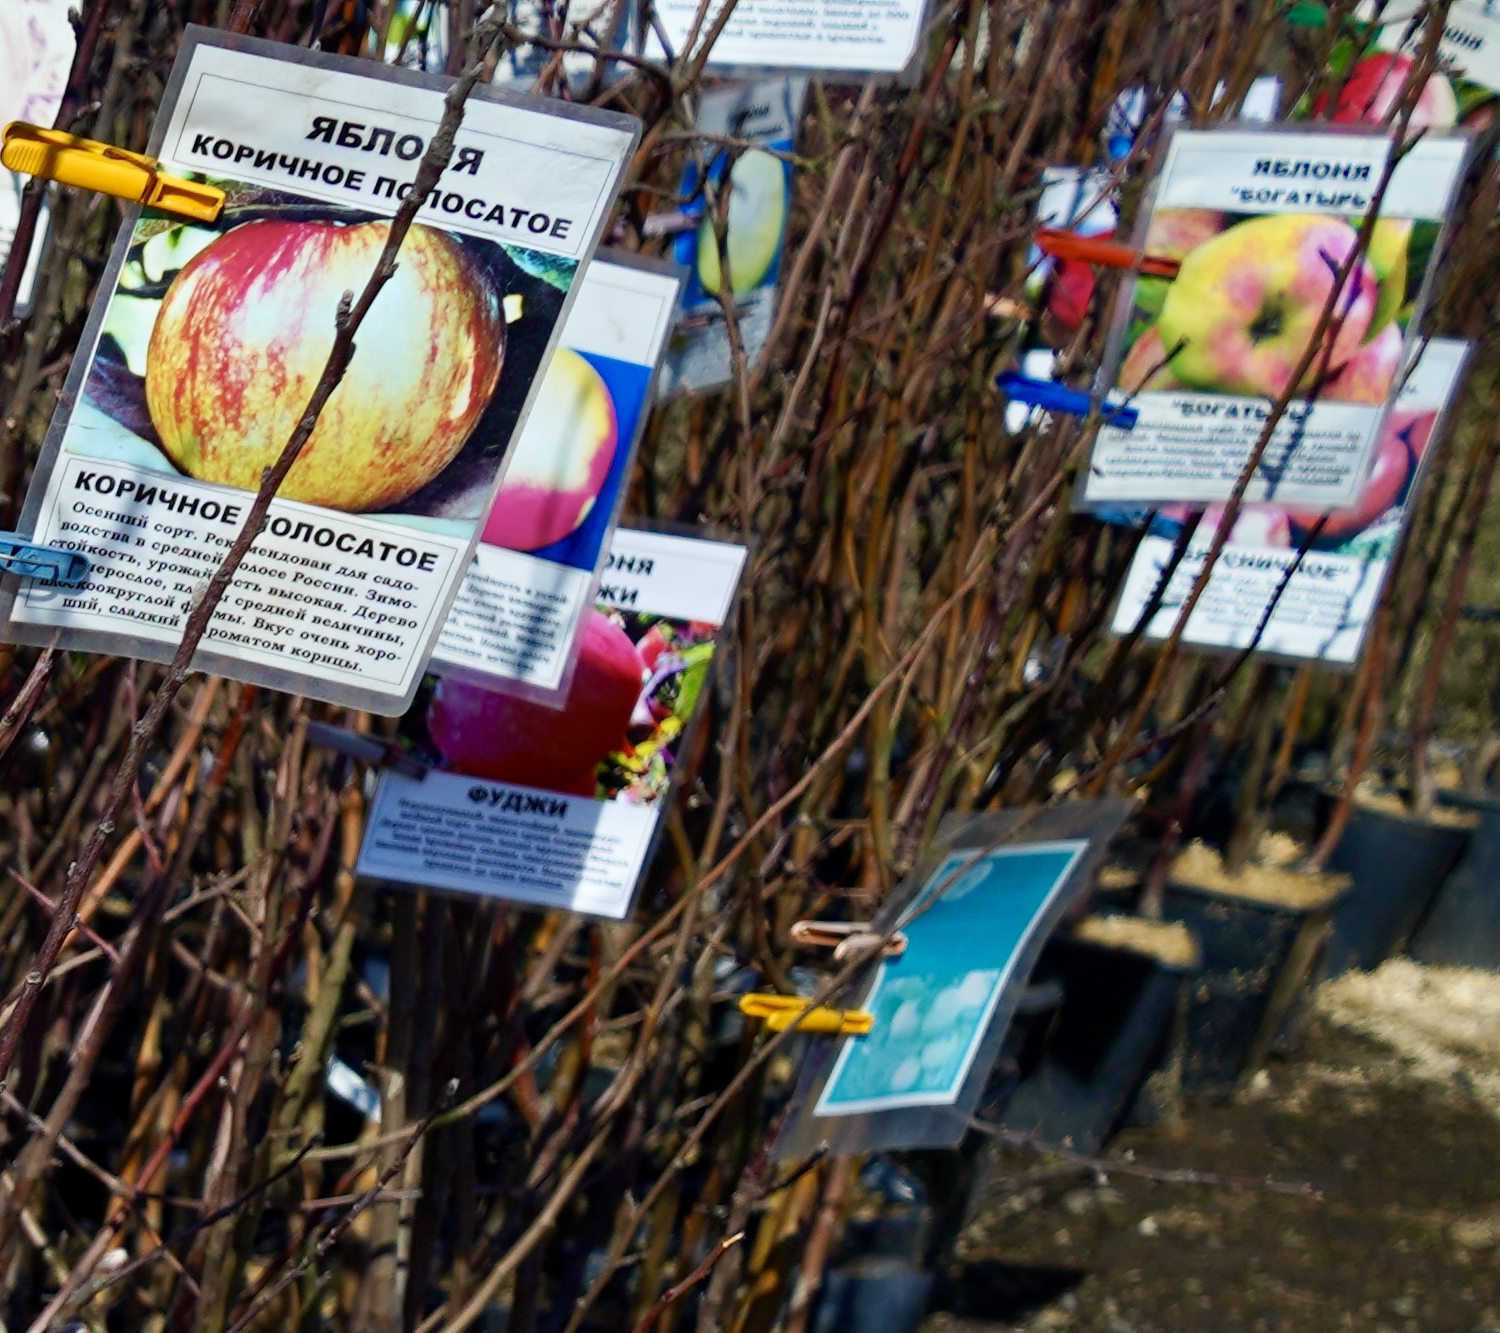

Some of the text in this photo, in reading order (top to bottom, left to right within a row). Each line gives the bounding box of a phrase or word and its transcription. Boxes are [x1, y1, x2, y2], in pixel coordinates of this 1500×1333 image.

[191, 133, 367, 192] КОРИЧНОЕ
[305, 115, 485, 175] ЯБЛОЯ
[1252, 158, 1371, 181] ЯБЛОНЯ
[74, 470, 243, 525] КОРИЧНОЕ
[61, 520, 418, 610] водства в средней олосе России. Зимо-
[72, 501, 419, 591] Осенний сорт. Рекмендован для садо-
[49, 538, 141, 567] стойкость,
[268, 586, 347, 613] высокая.
[352, 605, 418, 630] Дерево
[62, 596, 363, 672] ший, сладкий роматом корицы.
[235, 597, 307, 621] средней
[312, 615, 404, 647] величины,
[252, 617, 296, 637] Вкус
[300, 631, 350, 651] очень
[354, 643, 402, 662] хоро-
[467, 785, 570, 820] ФУДЖИ
